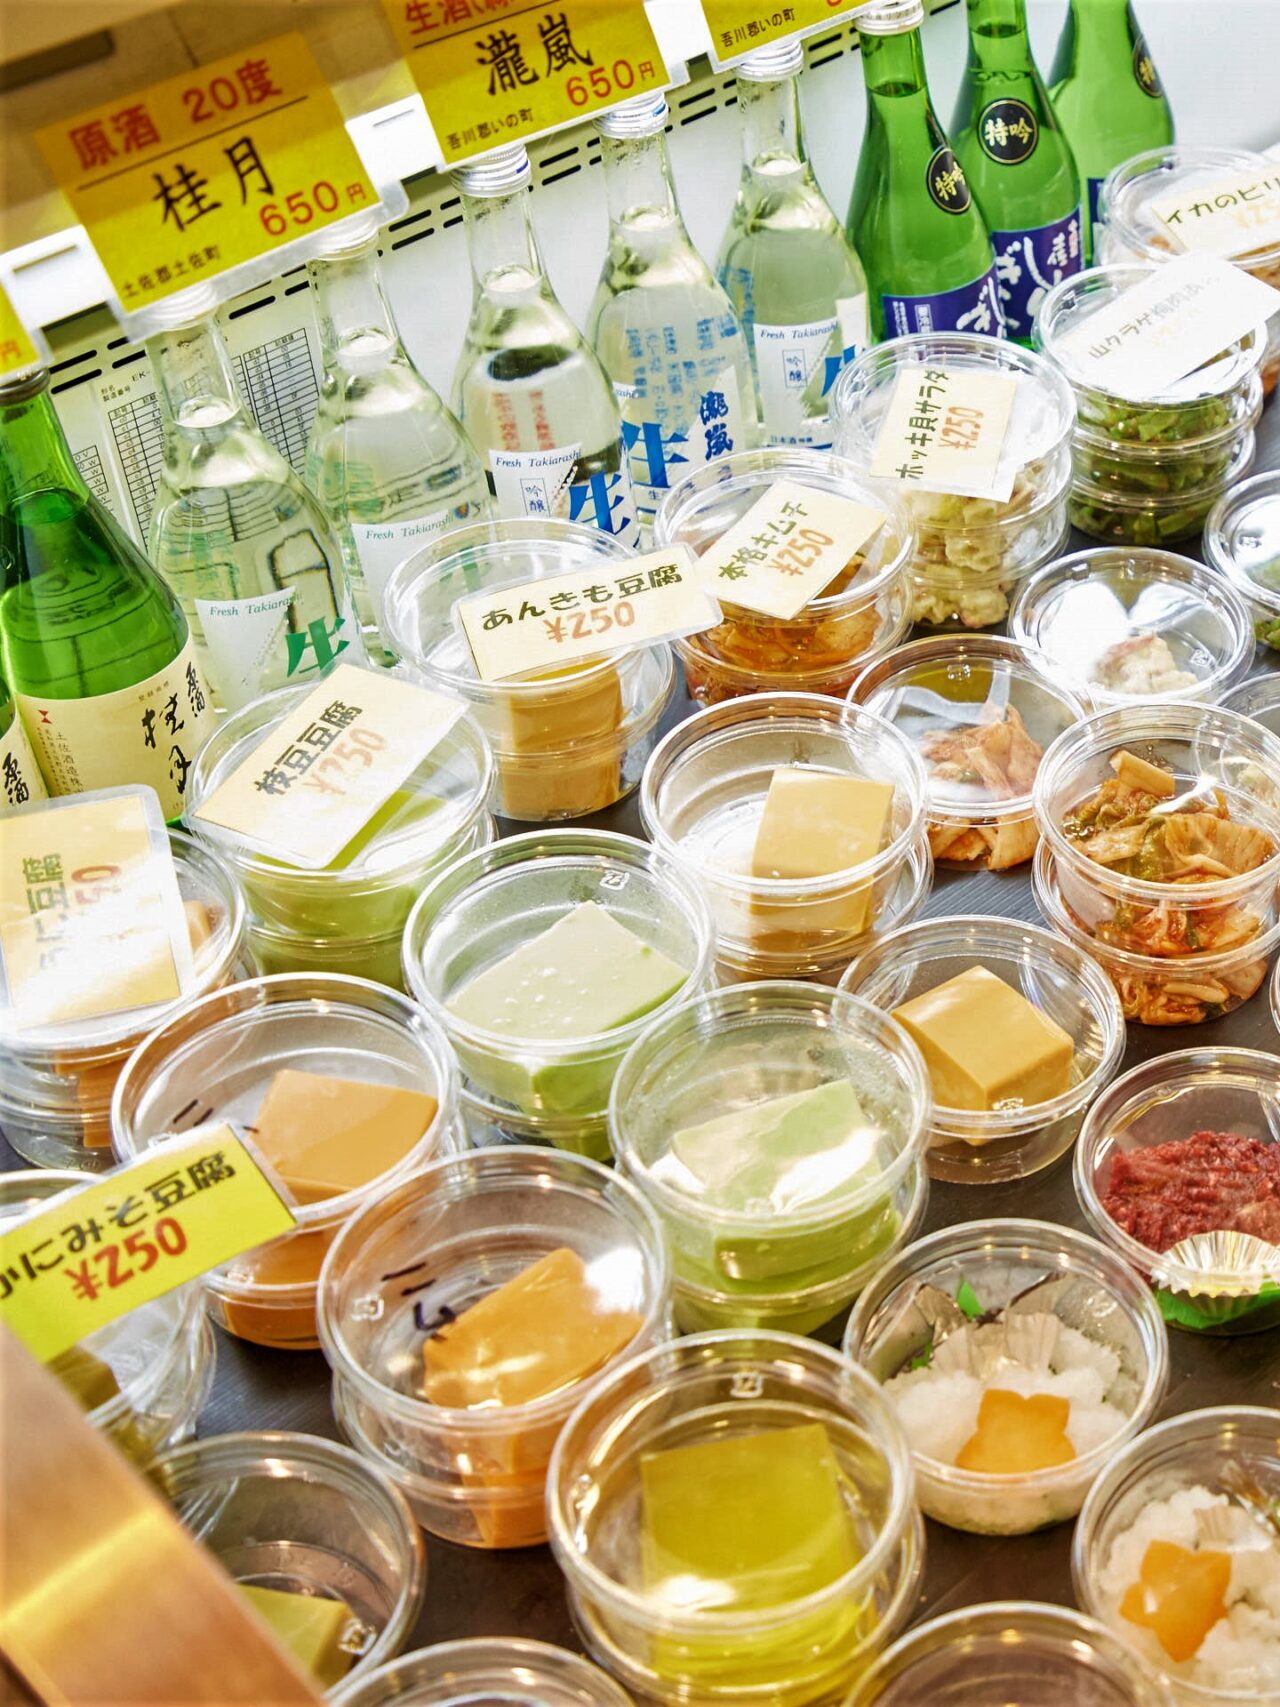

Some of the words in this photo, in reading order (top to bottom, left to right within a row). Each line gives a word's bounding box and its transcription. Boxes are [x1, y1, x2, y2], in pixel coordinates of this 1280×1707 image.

[565, 58, 657, 107] 650円
[68, 104, 161, 171] 原酒
[181, 58, 283, 125] 20度
[983, 117, 1034, 148] 特吟
[153, 136, 275, 233] 桂月
[258, 181, 367, 237] 650円
[760, 328, 786, 340] Fresh
[938, 405, 985, 451] ¥250
[495, 456, 522, 468] Fresh
[528, 449, 583, 468] Takiarashi
[568, 470, 632, 536] 生
[366, 529, 395, 540] Fresh
[716, 500, 811, 583] 本格キムチ
[766, 527, 837, 578] ¥250
[210, 605, 239, 617] Fresh
[481, 563, 685, 632] あんきも豆腐
[541, 600, 636, 644] ¥250
[253, 699, 364, 797] 枝豆豆腐
[62, 1216, 188, 1302] ¥250
